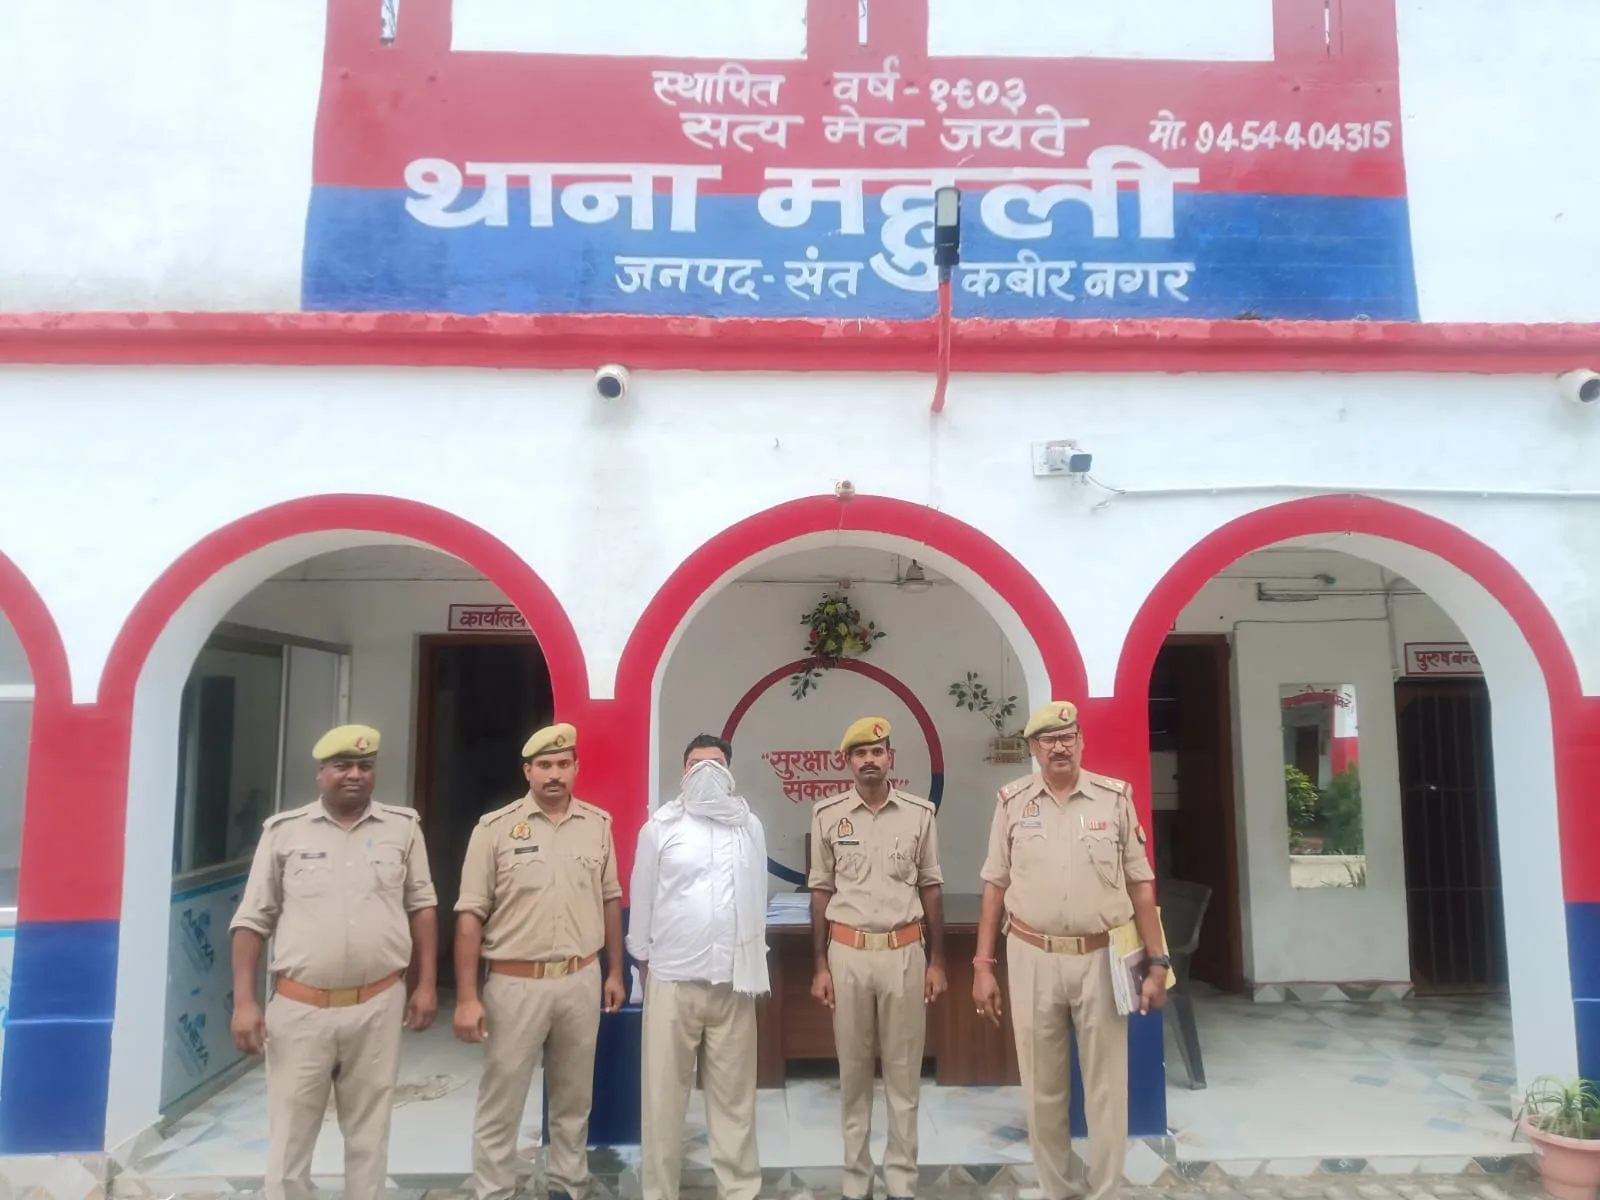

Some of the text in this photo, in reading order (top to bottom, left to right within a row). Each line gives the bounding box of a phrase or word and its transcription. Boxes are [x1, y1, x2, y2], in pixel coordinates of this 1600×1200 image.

[652, 63, 786, 108] स्थापित
[679, 104, 1090, 156] सत्य मेव जयते
[1195, 119, 1393, 153] 9454404315
[403, 145, 1200, 292] थाना महुली
[958, 248, 1077, 302] कबीर
[1081, 261, 1197, 302] नगर
